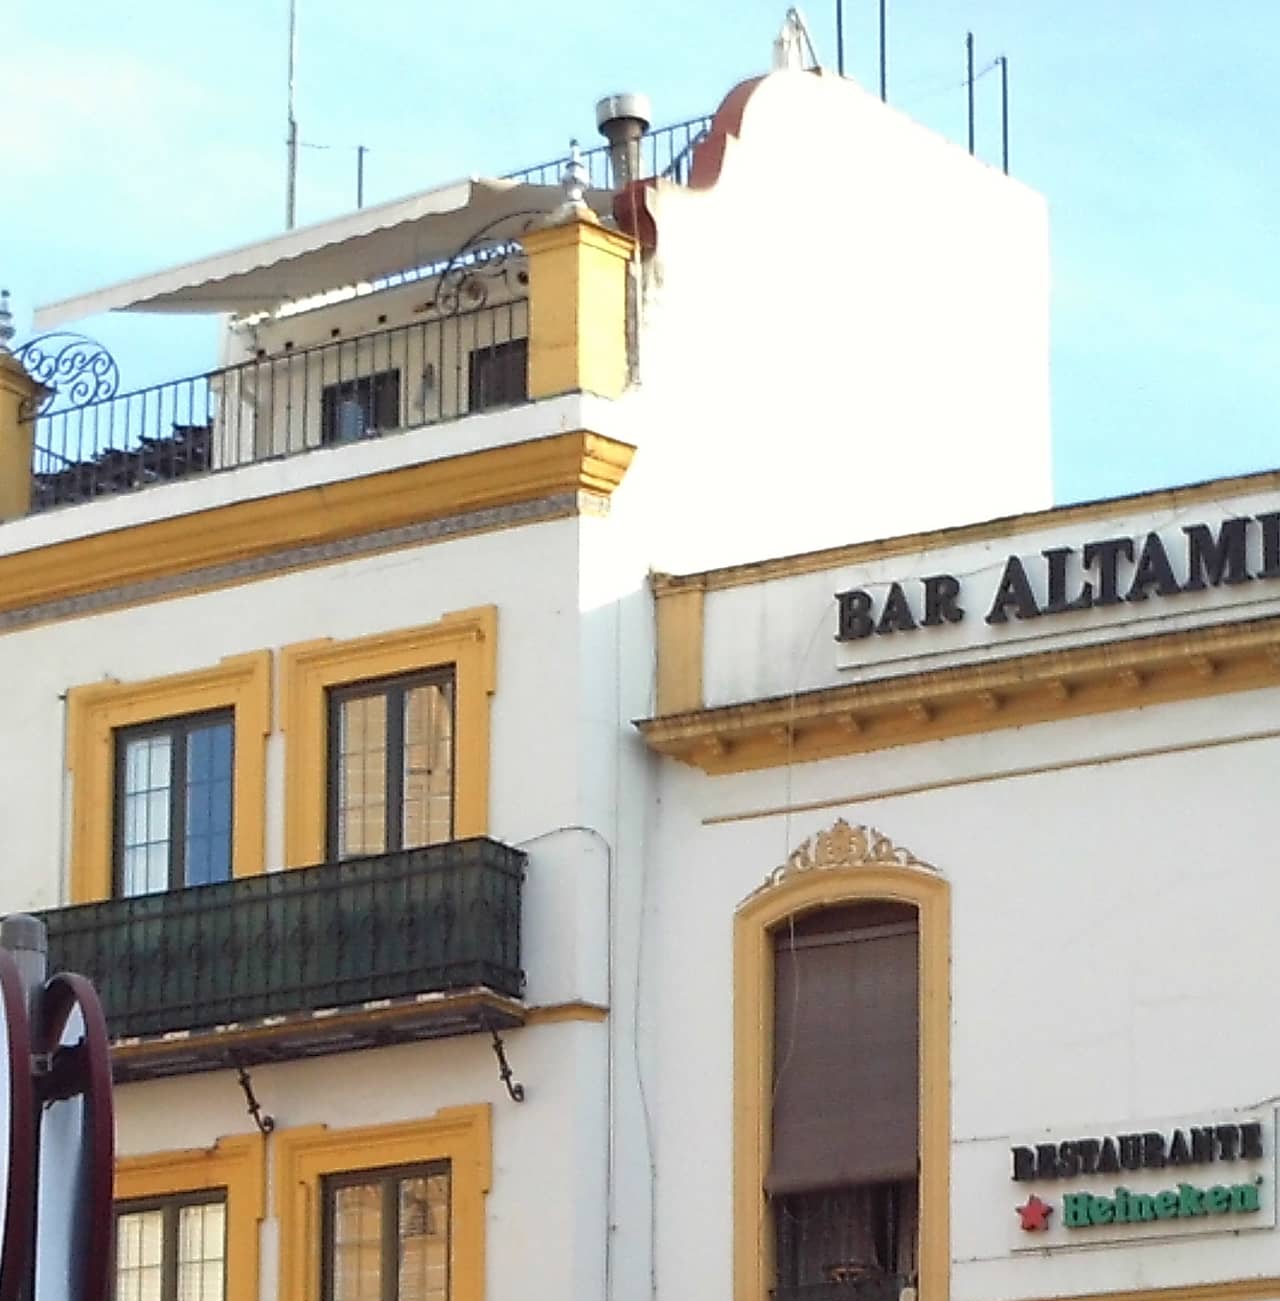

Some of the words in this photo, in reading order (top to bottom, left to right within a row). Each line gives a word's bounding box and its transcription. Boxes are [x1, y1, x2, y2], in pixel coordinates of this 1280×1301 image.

[834, 574, 966, 642] BAR
[1011, 1122, 1263, 1181] RESTAURANTE
[1063, 1182, 1261, 1228] Heineken
